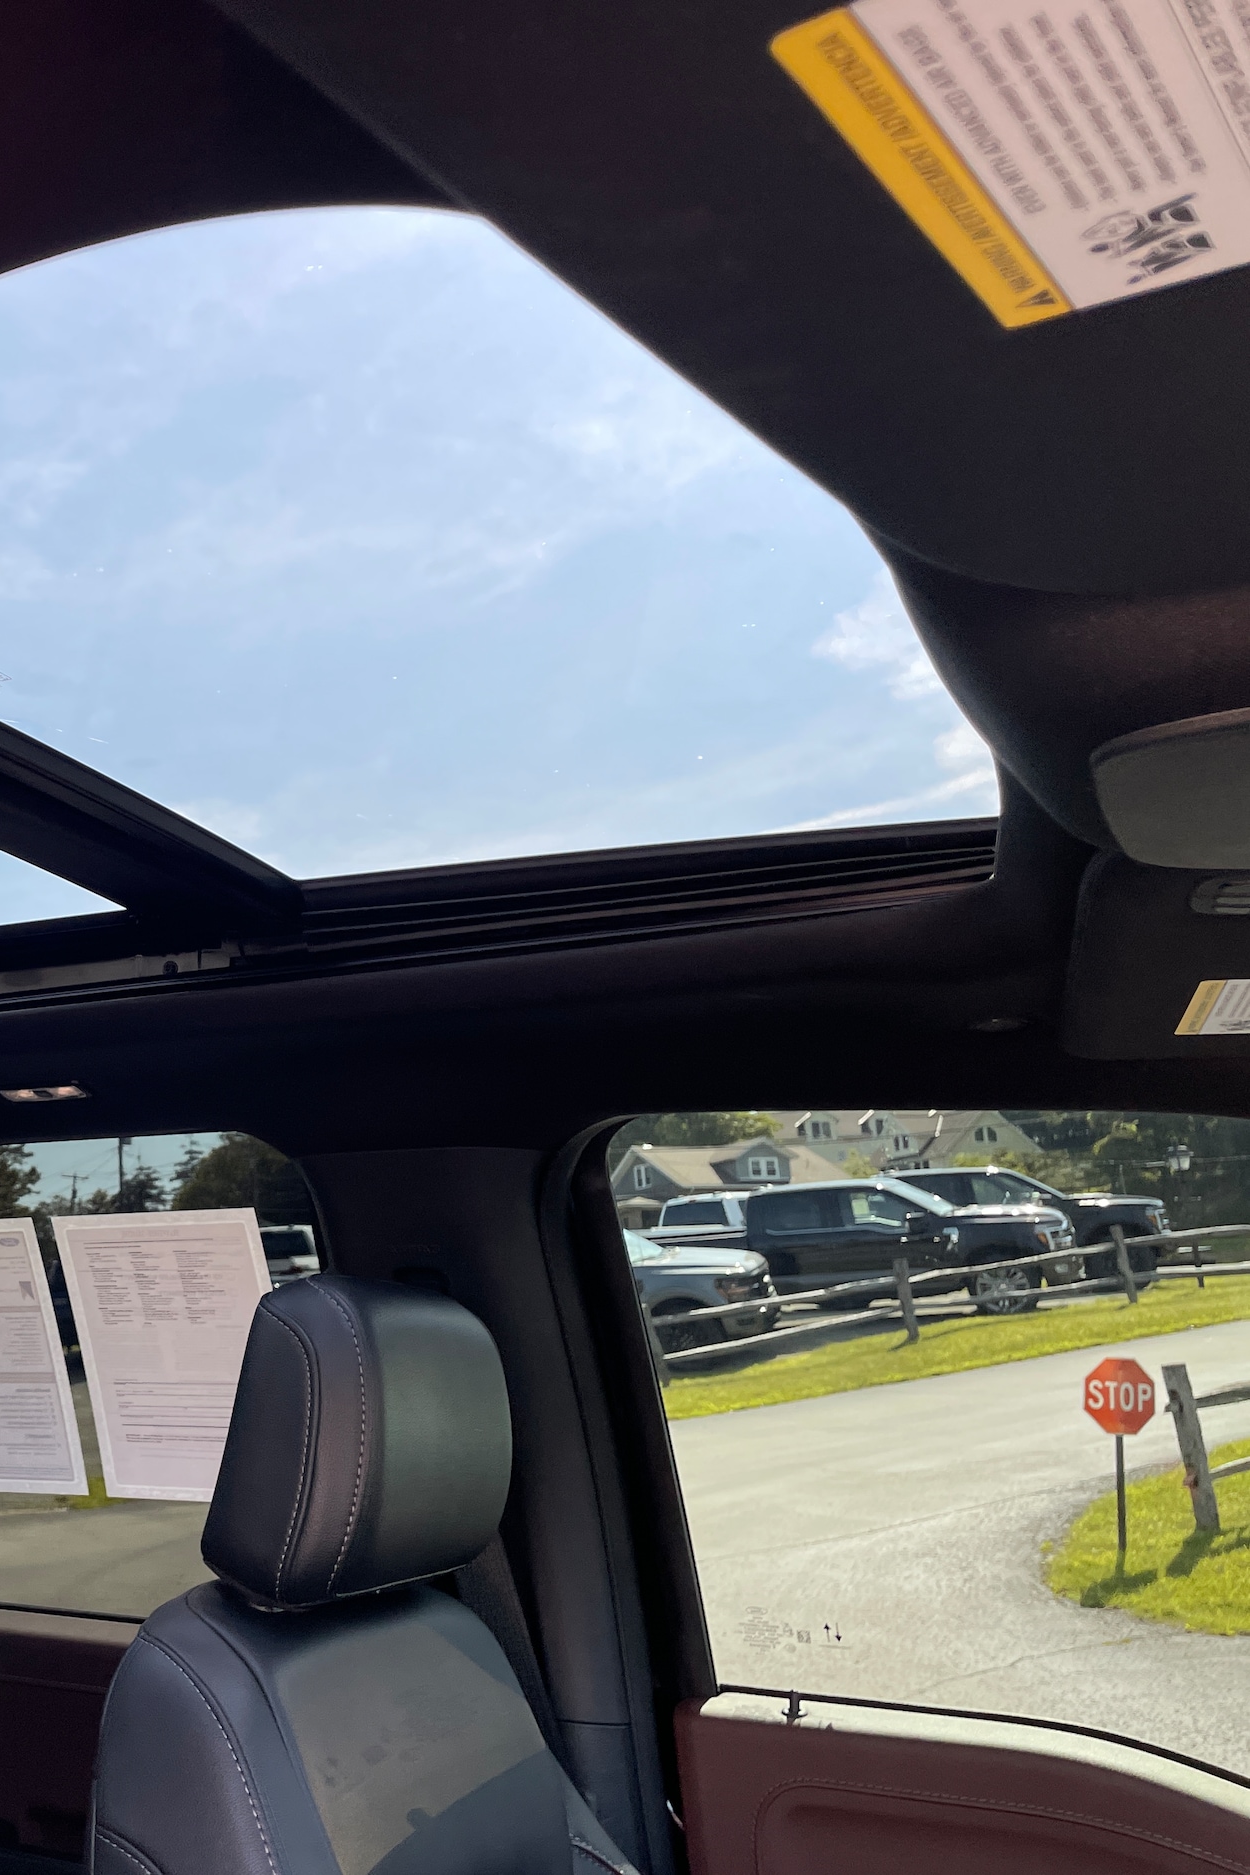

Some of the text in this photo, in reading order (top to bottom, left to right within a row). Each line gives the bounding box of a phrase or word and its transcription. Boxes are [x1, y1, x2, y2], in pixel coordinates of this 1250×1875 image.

[923, 66, 959, 91] AIR
[940, 90, 1007, 156] ADVANCED
[987, 155, 1026, 186] WITH
[1008, 184, 1047, 214] EVEN
[984, 245, 1035, 292] WARNING
[1088, 1379, 1152, 1412] STOP
